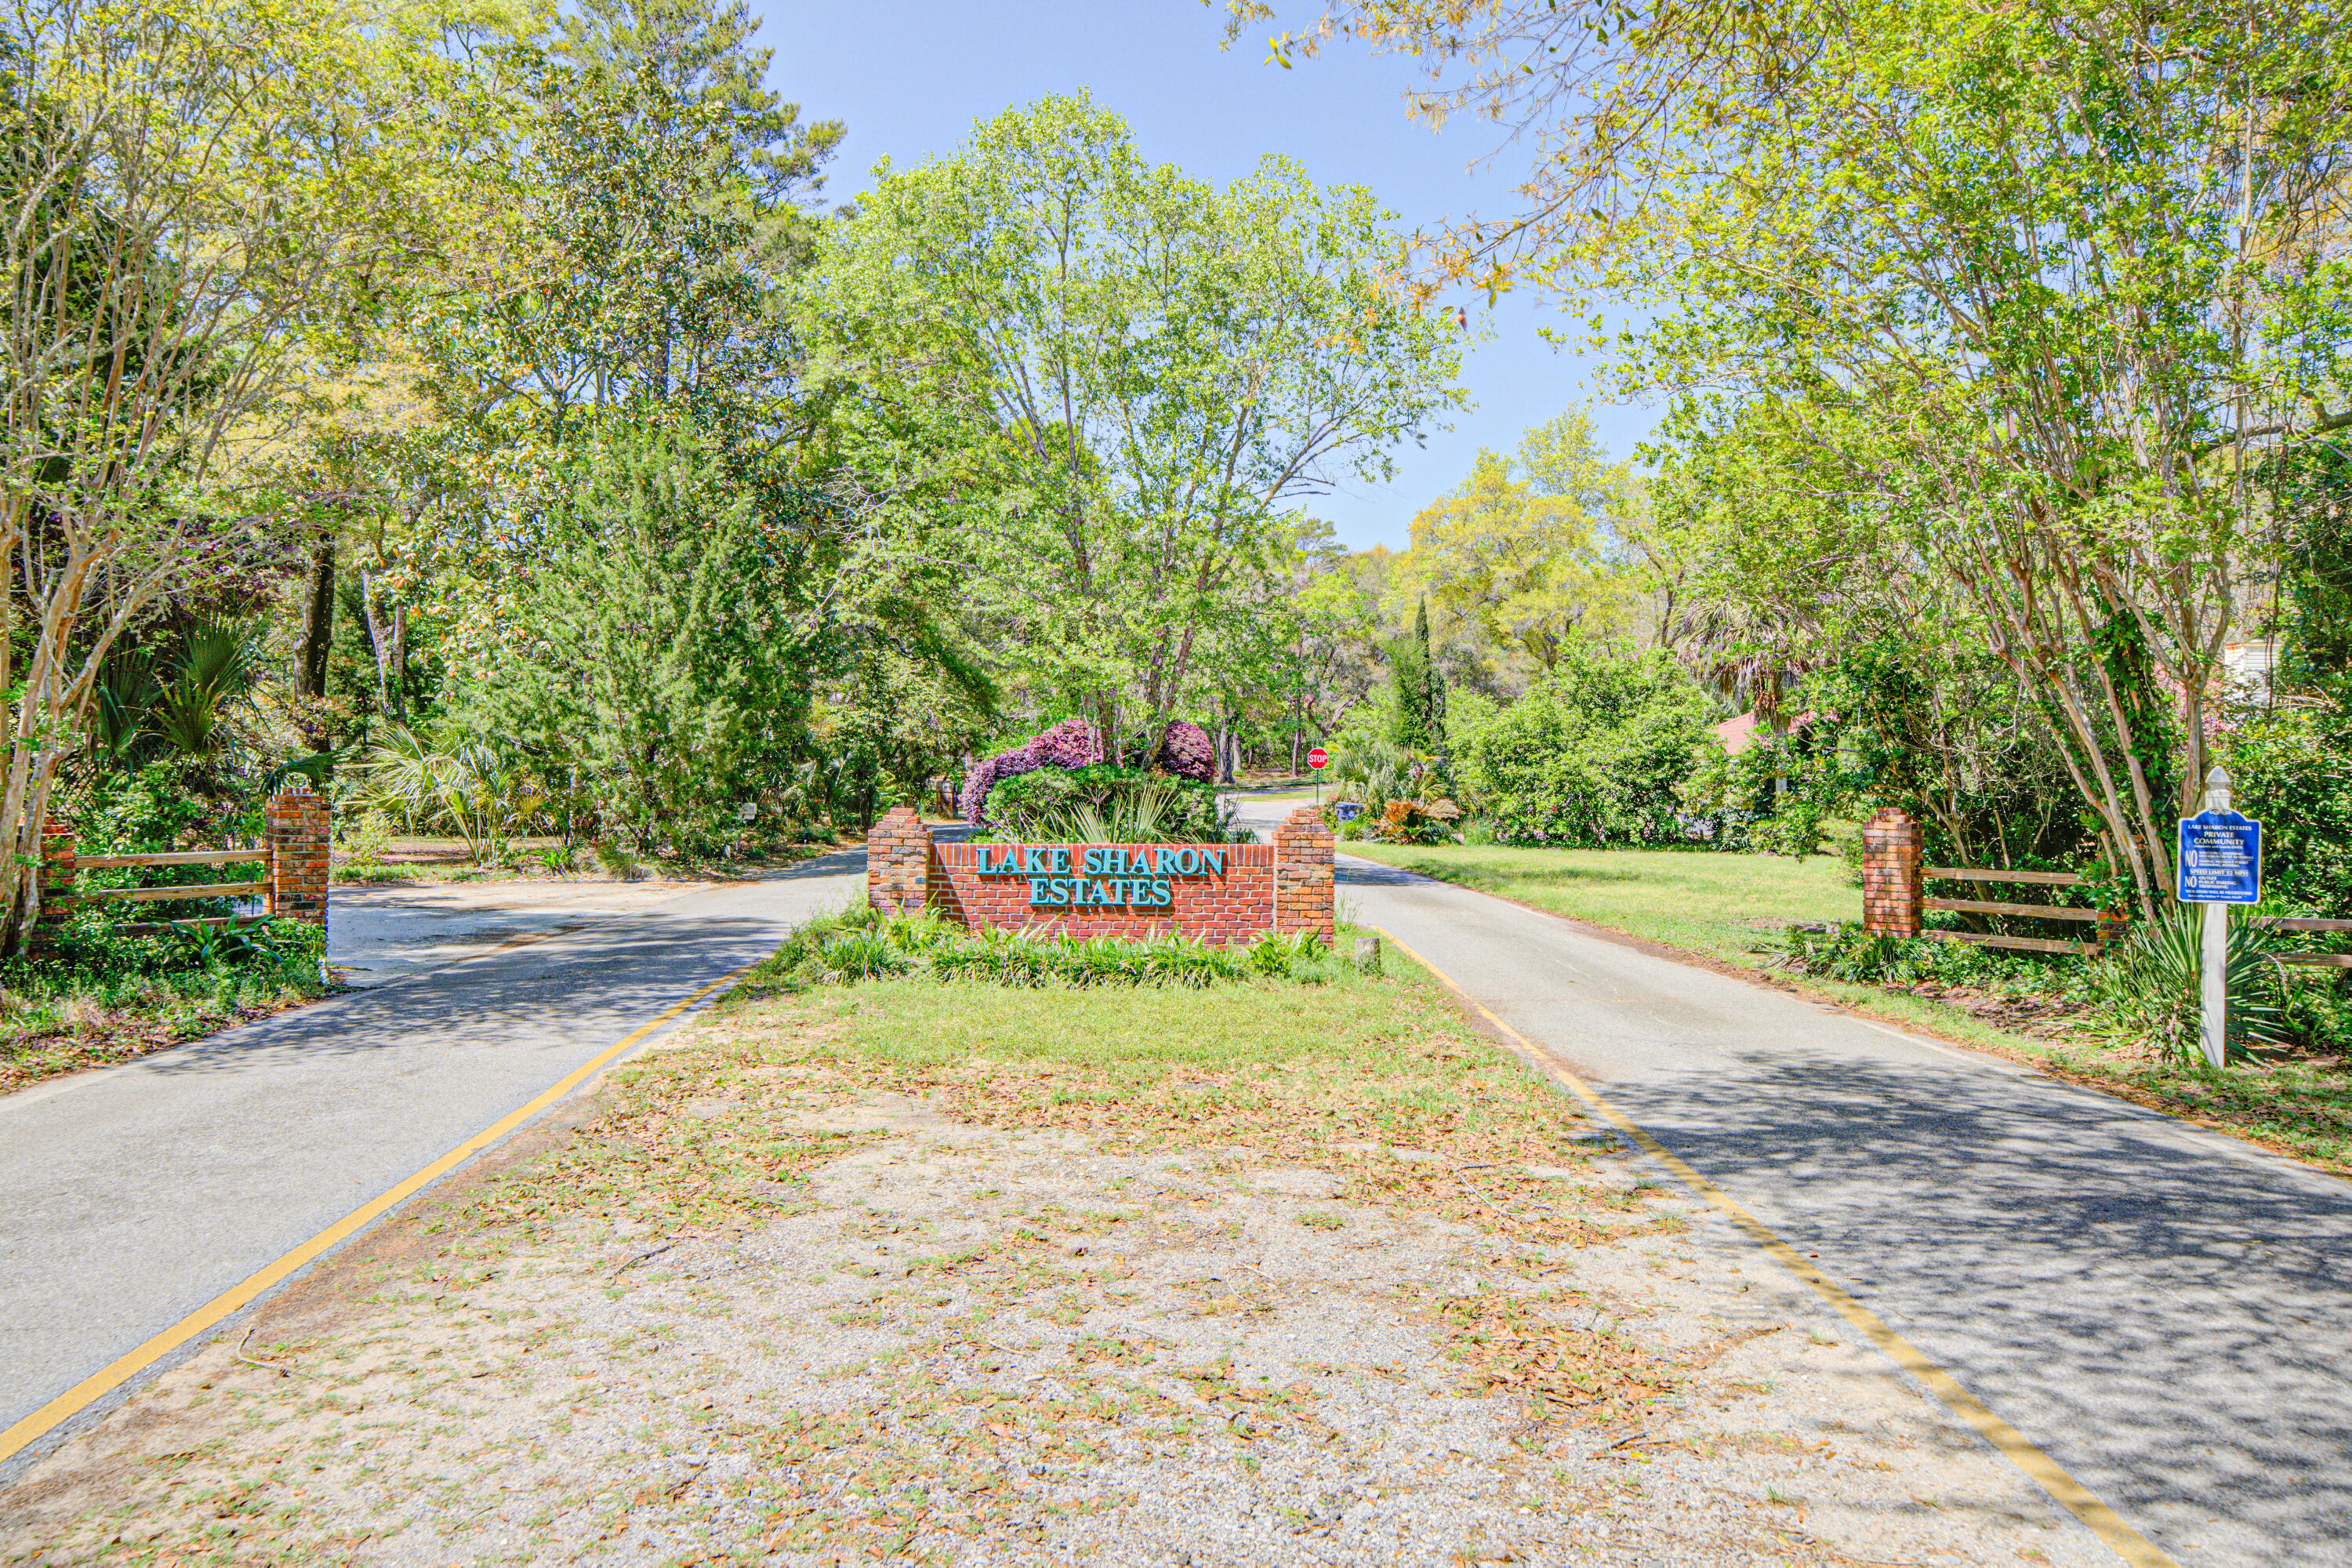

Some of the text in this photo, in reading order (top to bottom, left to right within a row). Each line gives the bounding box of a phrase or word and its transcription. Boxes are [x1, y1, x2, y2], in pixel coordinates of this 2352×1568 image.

[1308, 754, 1327, 763] STOP
[976, 848, 1226, 877] LAKE SHARON
[2185, 850, 2198, 868] NO
[2184, 876, 2198, 888] NO
[1028, 878, 1172, 907] ESTATES
